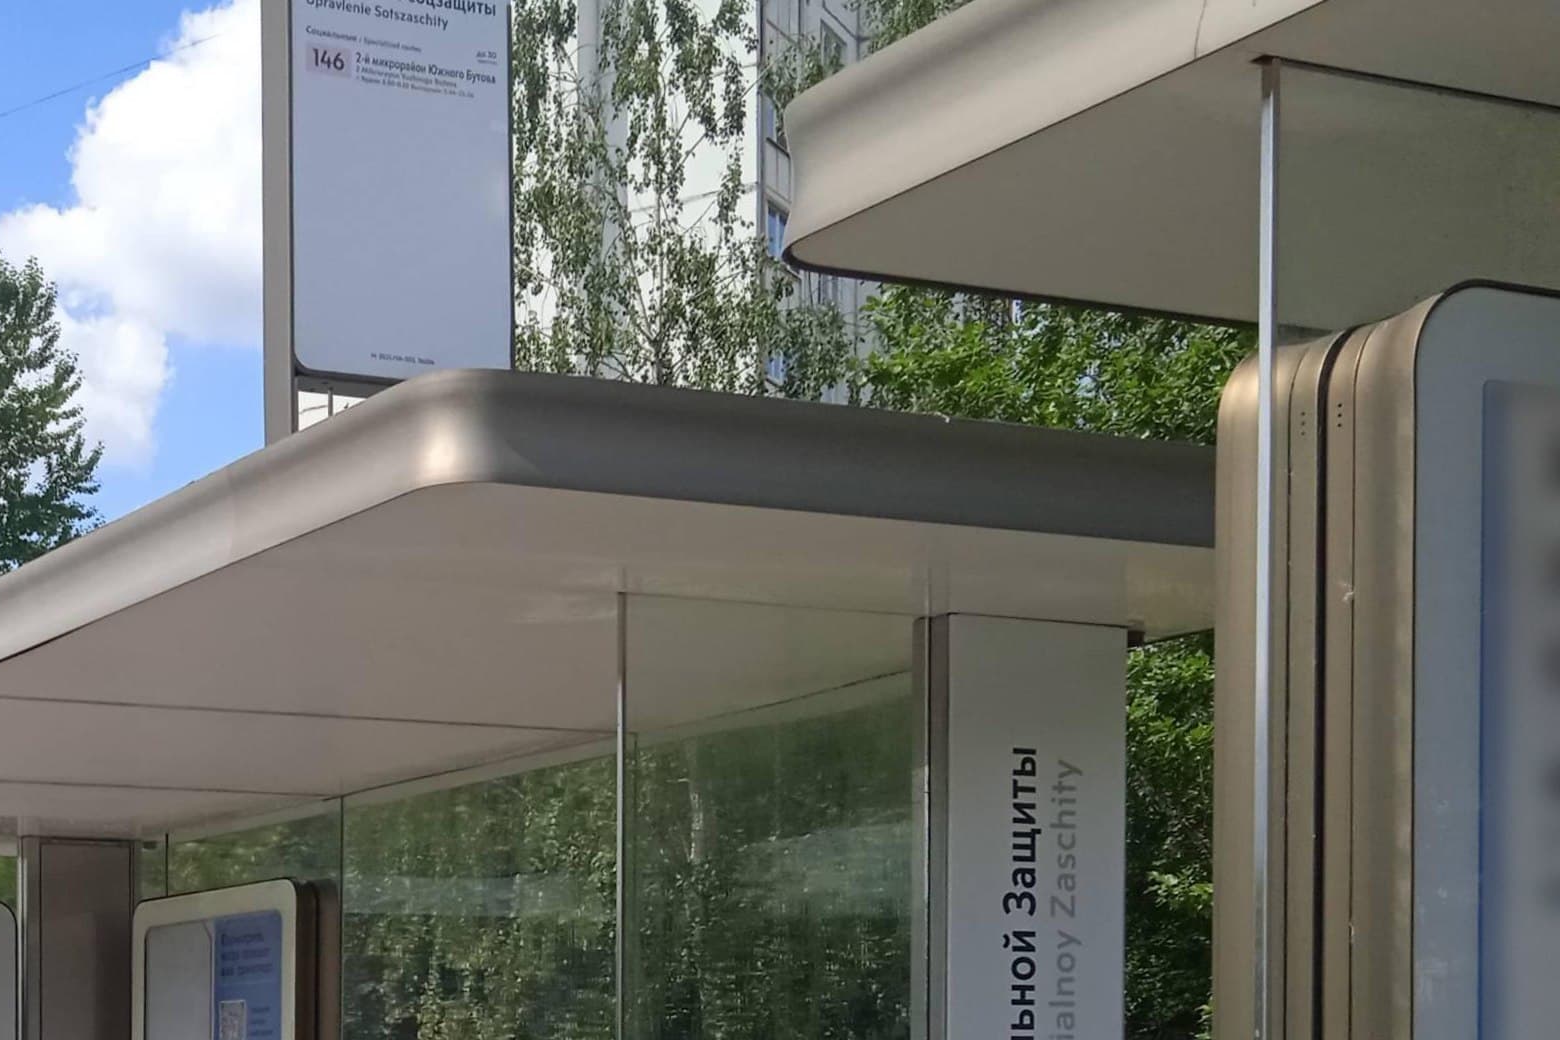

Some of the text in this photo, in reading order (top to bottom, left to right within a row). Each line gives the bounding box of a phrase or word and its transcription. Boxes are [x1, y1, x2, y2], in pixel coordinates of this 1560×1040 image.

[374, 5, 449, 31] Sotszaschity
[312, 48, 345, 71] 146
[356, 52, 497, 85] 2-й микрорайон Южного Бутова
[1002, 748, 1042, 917] Защиты
[1049, 759, 1083, 918] Zaschity
